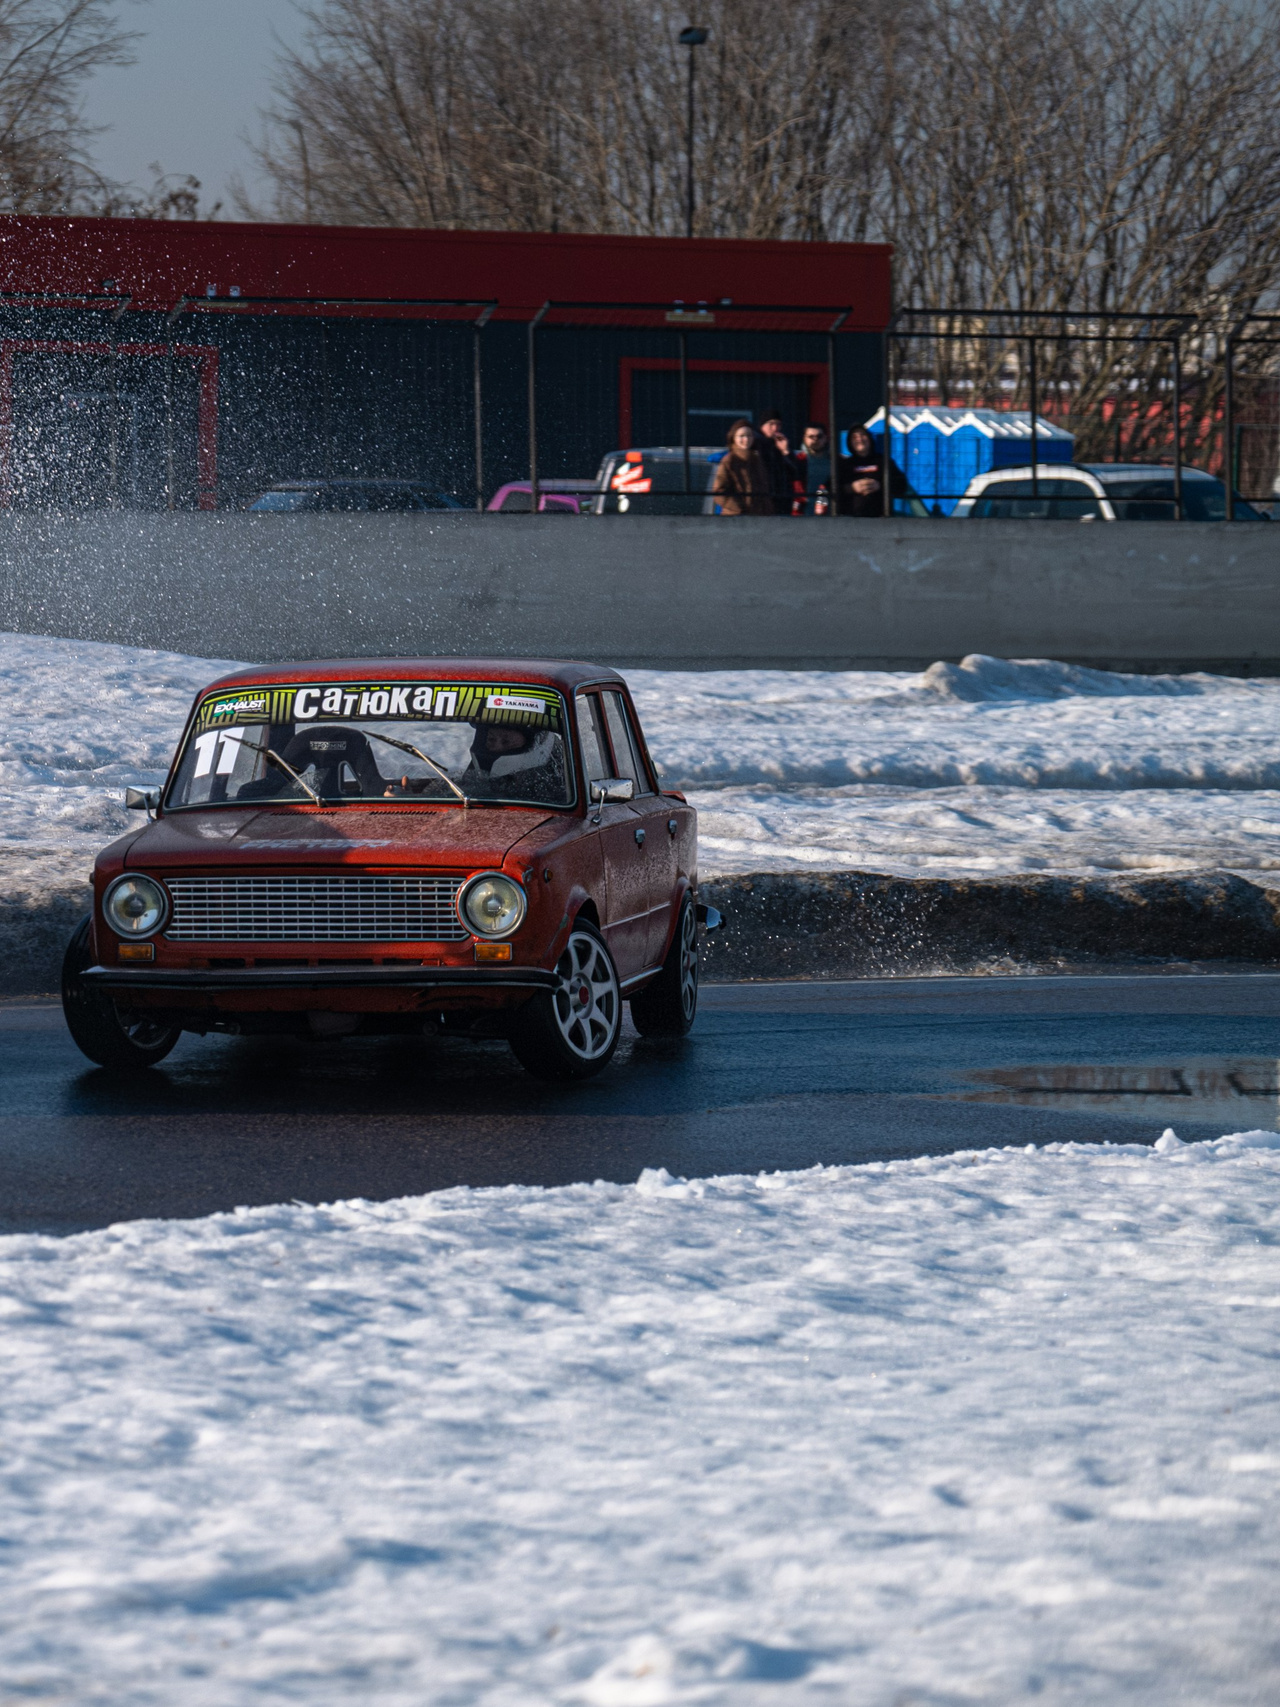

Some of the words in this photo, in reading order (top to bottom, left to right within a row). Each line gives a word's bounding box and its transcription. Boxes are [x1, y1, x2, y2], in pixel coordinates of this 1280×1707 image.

[214, 699, 266, 714] EXHAUST
[505, 701, 539, 709] TAKAYAMA
[194, 727, 245, 778] 11
